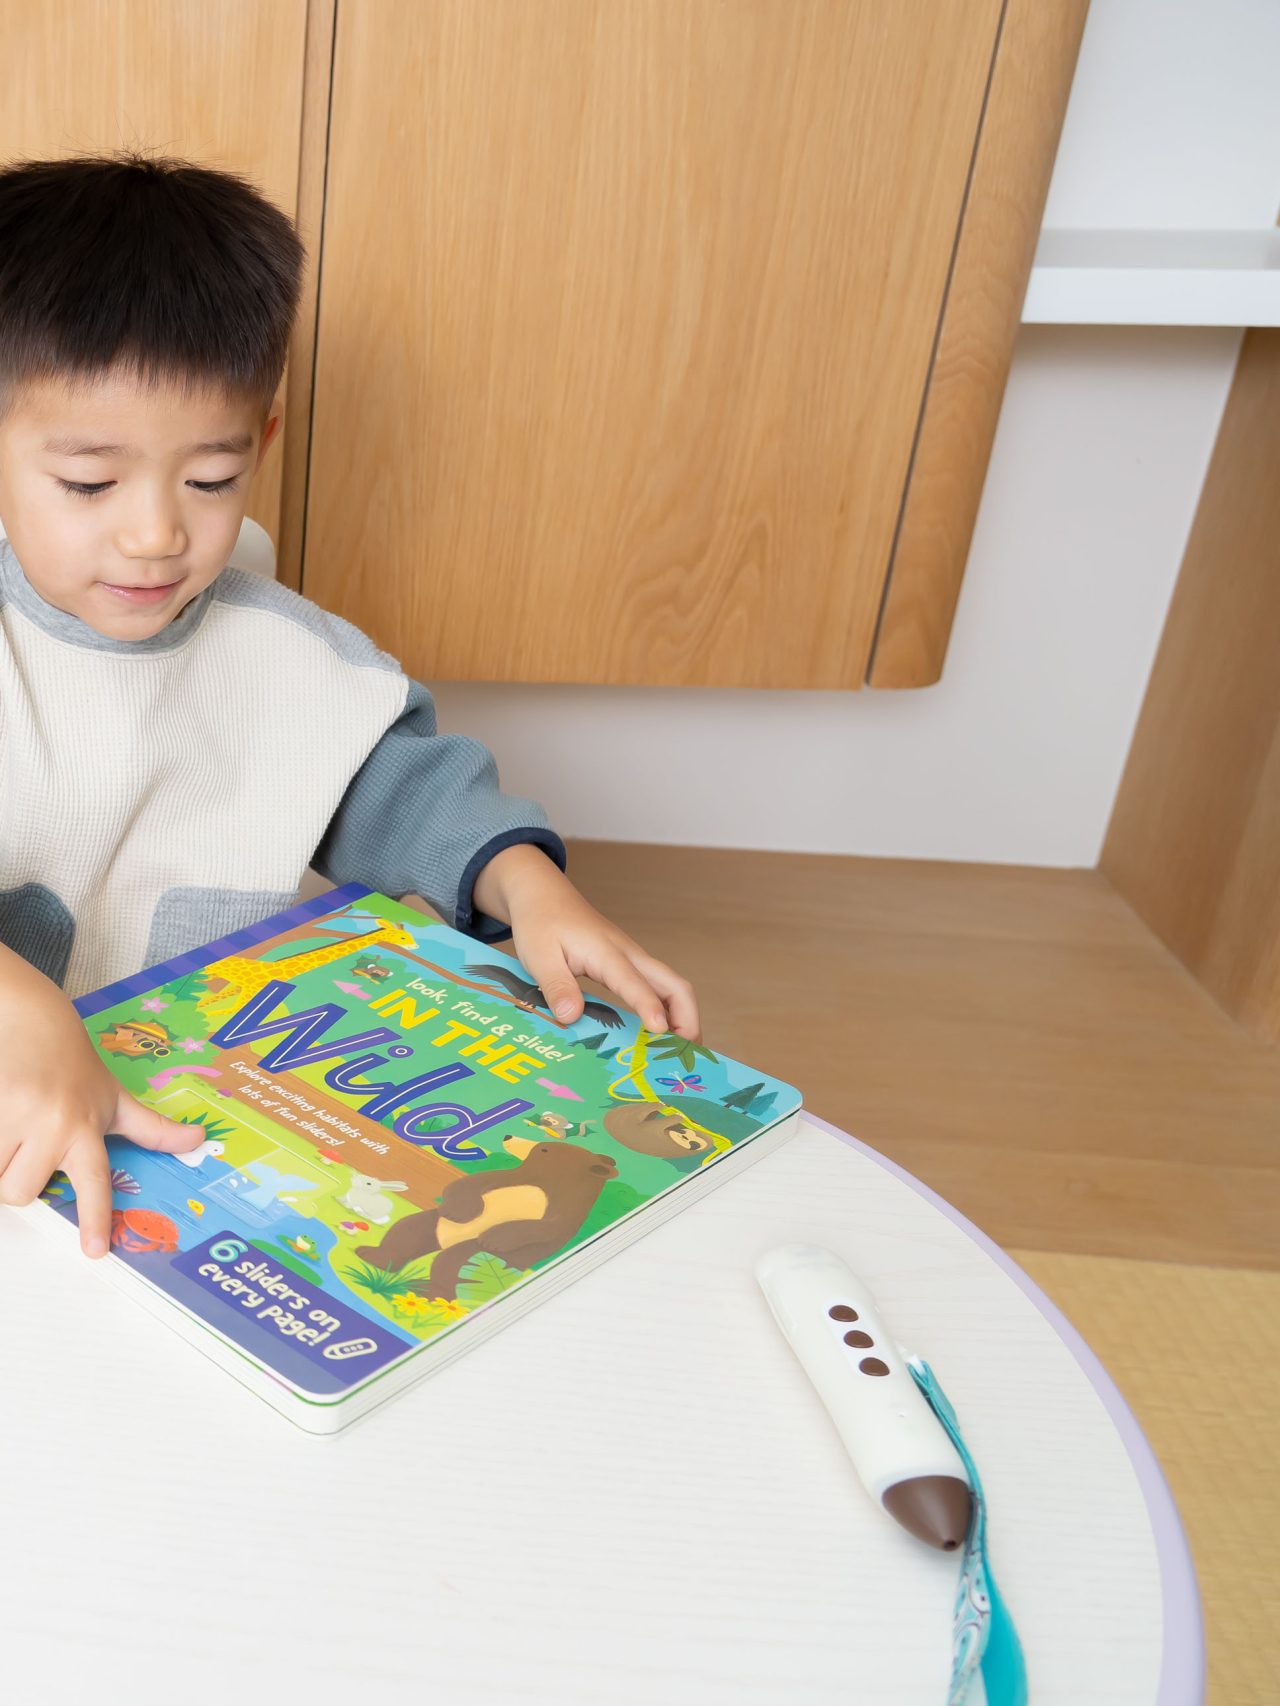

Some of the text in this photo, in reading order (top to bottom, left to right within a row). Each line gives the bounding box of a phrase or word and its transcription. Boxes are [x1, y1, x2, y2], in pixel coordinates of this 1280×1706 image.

[368, 988, 547, 1085] IN THE
[406, 978, 575, 1062] look, find & slide!
[208, 979, 535, 1160] Wild
[229, 1061, 391, 1156] Explore exciting habitats with
[238, 1084, 345, 1147] lots of fun sliders!
[198, 1262, 331, 1347] every page!
[209, 1239, 341, 1332] 6 sliders on
